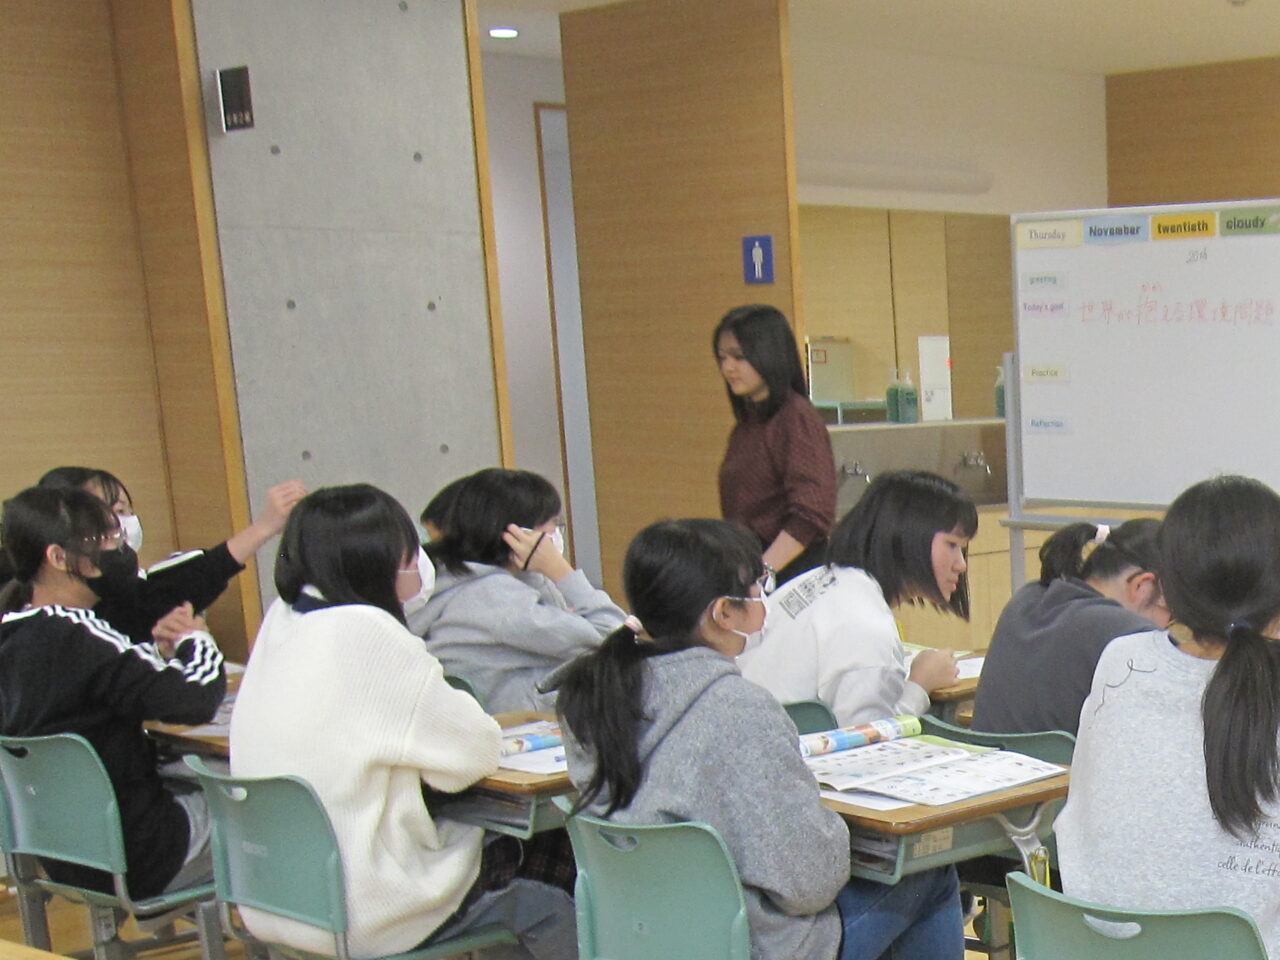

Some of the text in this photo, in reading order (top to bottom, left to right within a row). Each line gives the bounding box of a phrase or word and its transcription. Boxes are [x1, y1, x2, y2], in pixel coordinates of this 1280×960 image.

[1157, 220, 1209, 234] twentieth
[1225, 215, 1266, 231] cloudy
[1028, 230, 1066, 241] Thursday
[1088, 224, 1141, 238] November
[1217, 855, 1239, 871] celle
[1241, 859, 1253, 873] de
